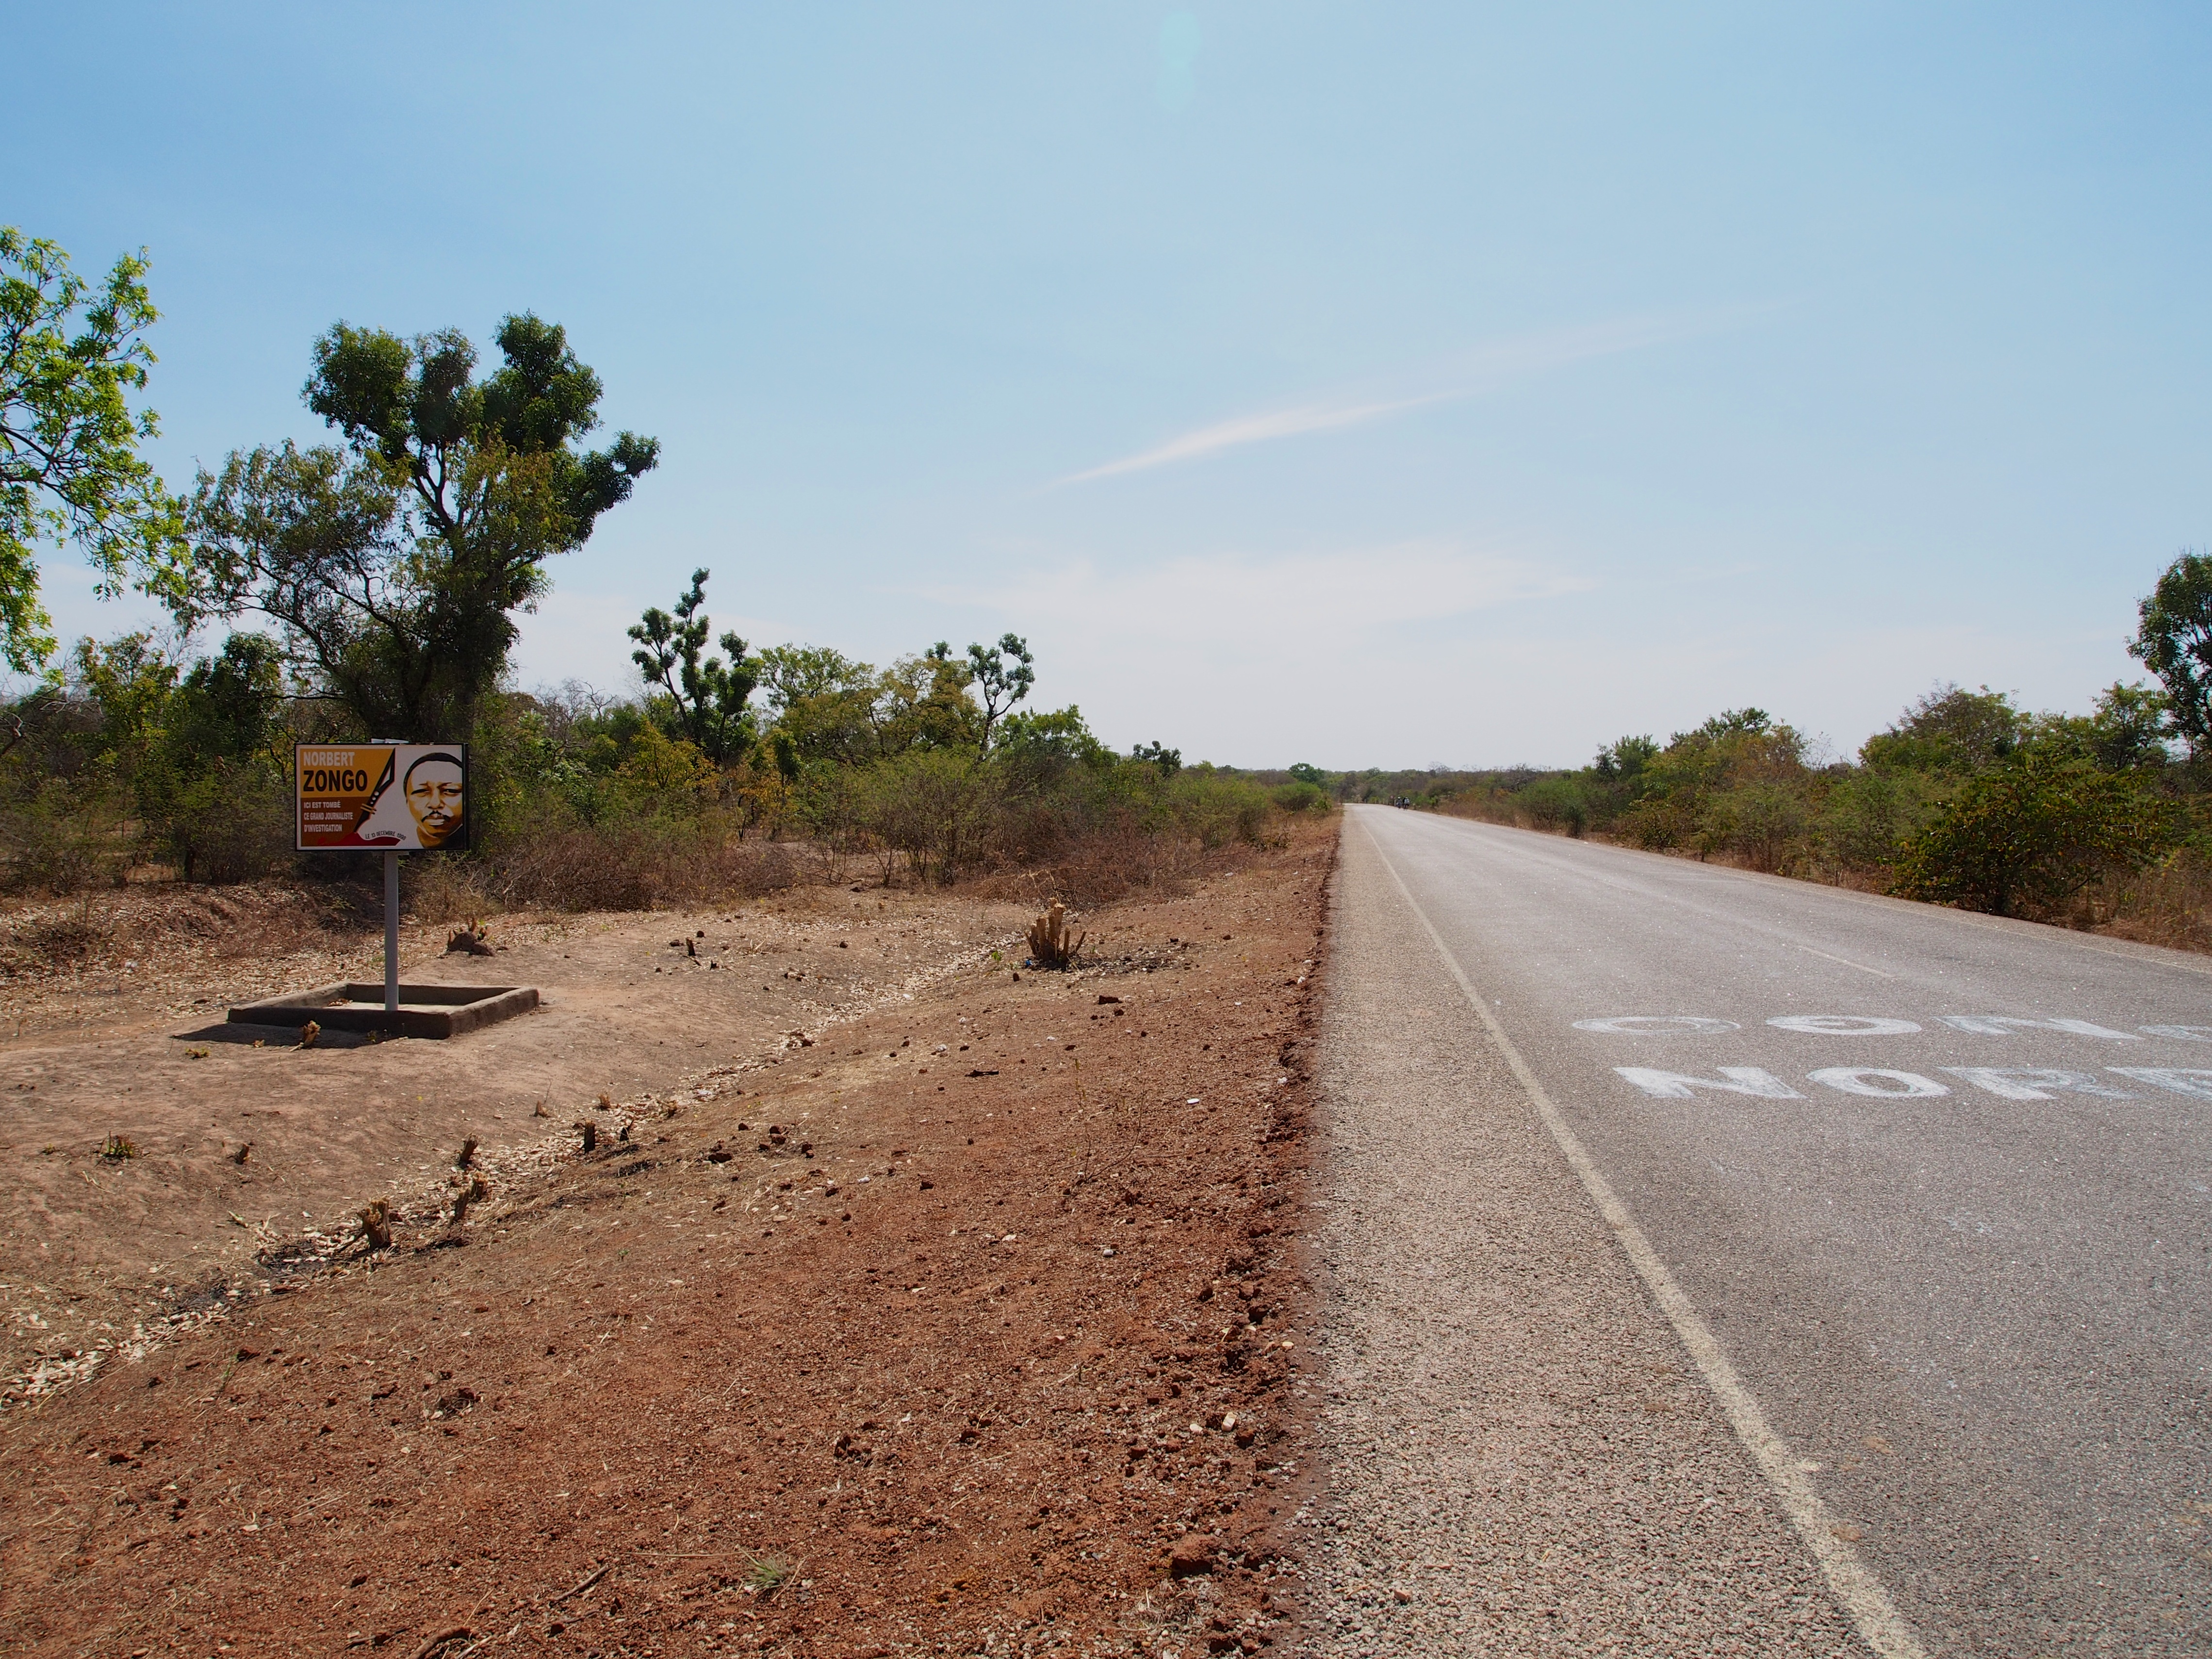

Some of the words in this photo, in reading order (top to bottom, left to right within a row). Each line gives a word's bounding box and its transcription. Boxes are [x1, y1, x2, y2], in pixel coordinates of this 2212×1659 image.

[303, 752, 355, 766] NORBERT
[303, 770, 368, 791] ZONGO
[322, 800, 341, 808] TOMBÉ
[325, 812, 353, 820] JOURNALISTE
